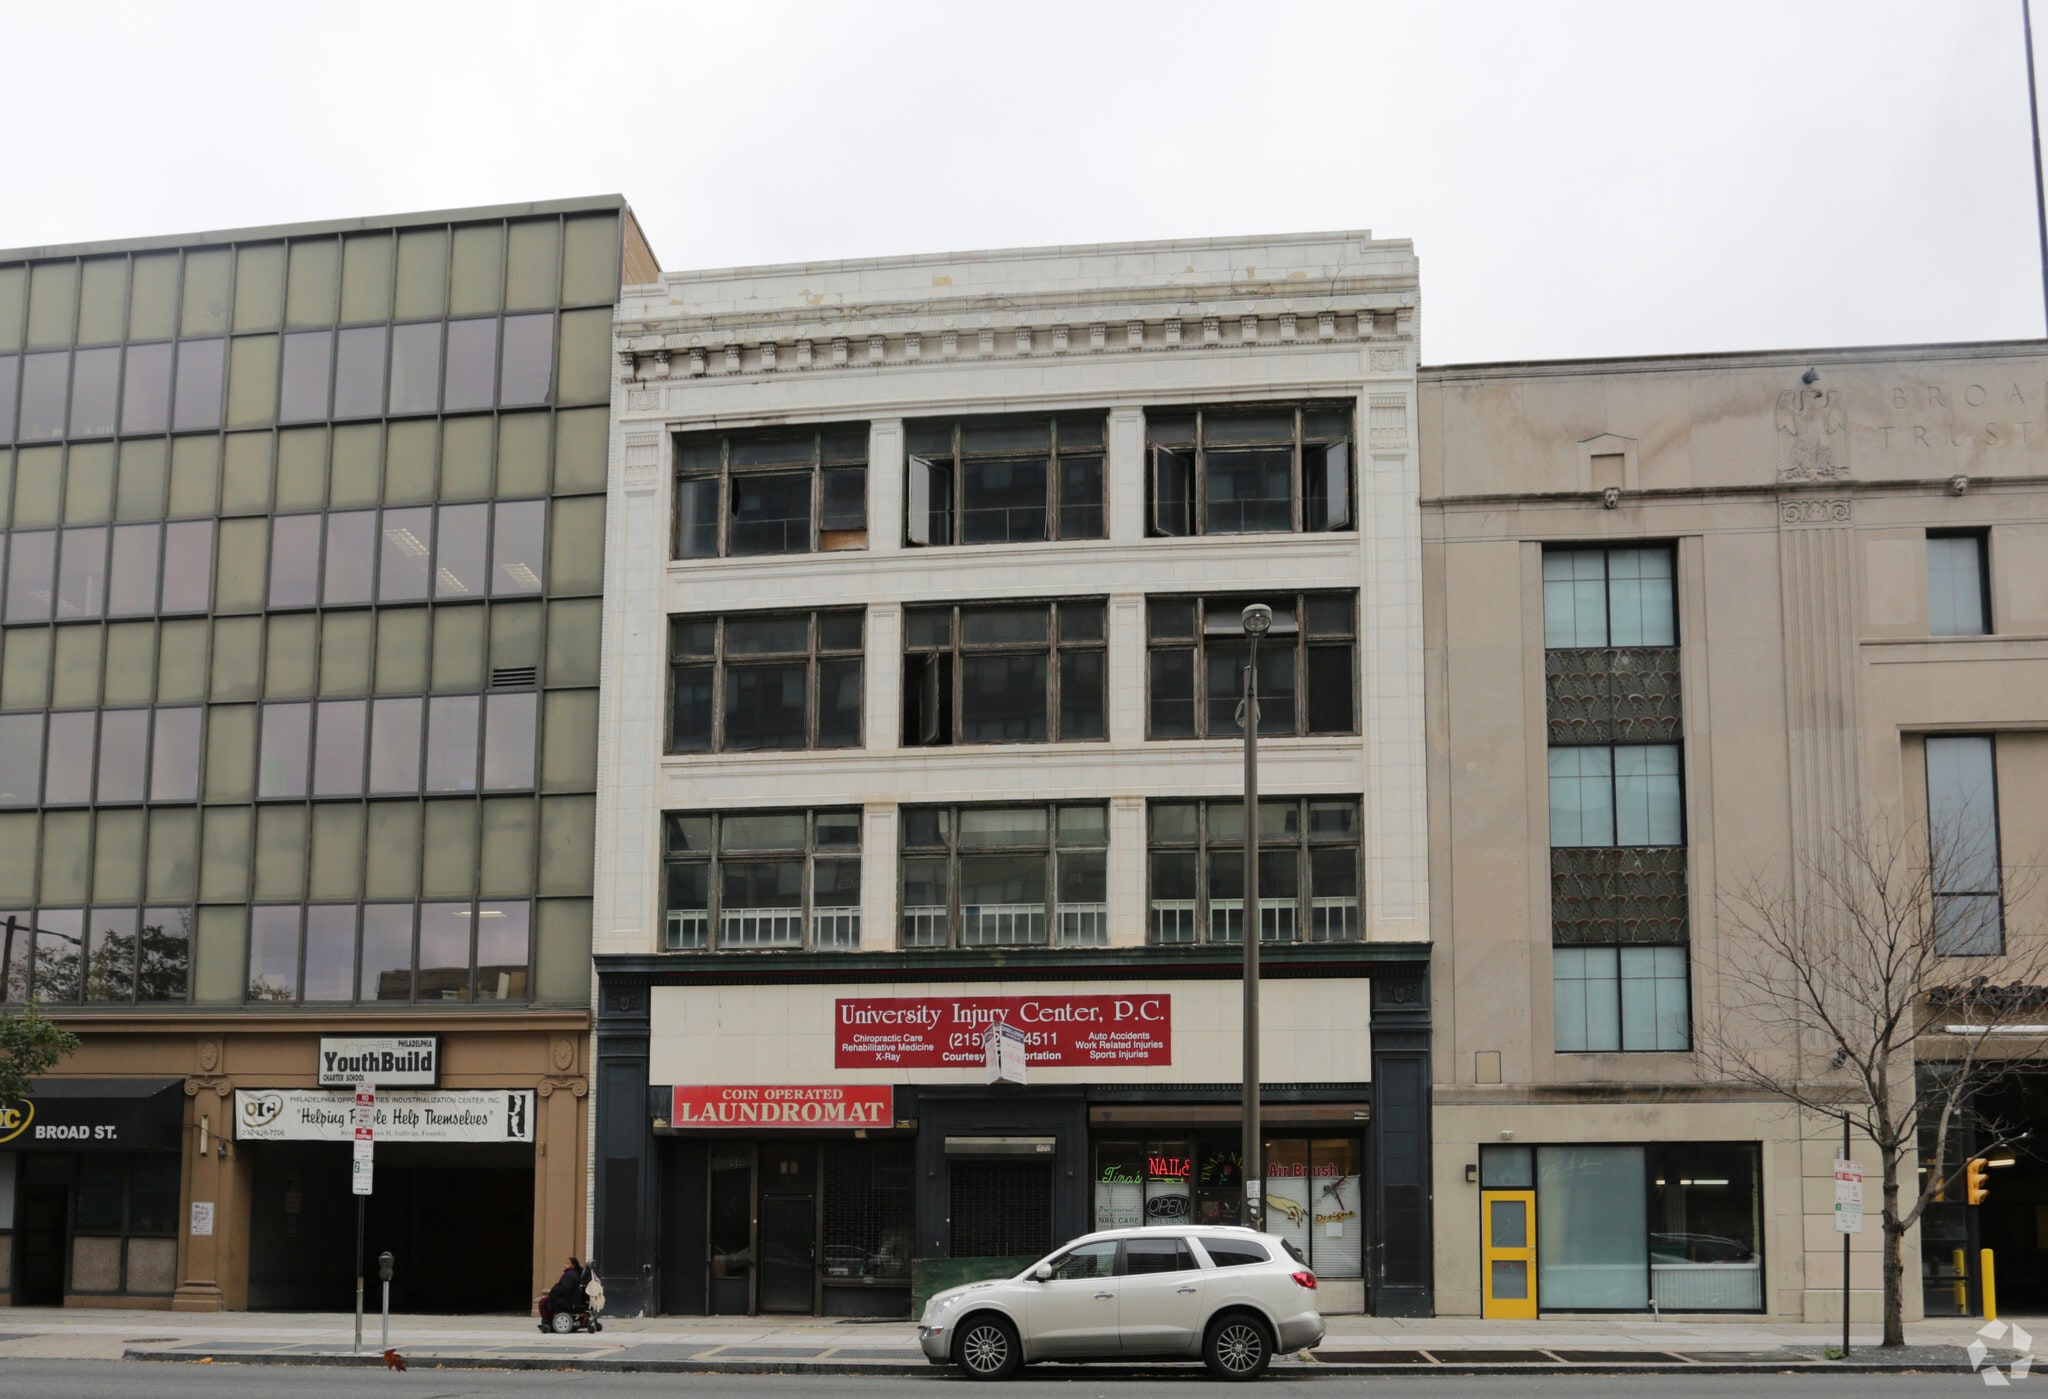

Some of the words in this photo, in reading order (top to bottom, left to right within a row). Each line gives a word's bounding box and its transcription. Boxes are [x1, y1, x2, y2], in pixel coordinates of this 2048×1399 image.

[1892, 383, 2048, 409] BROA
[1877, 421, 2032, 449] TRUST
[841, 1004, 942, 1031] University
[952, 1003, 1010, 1030] Injury
[1020, 1002, 1104, 1023] Center,
[1113, 1000, 1165, 1021] P.C.
[853, 1034, 902, 1043] Chiropractic
[903, 1033, 923, 1042] Care
[949, 1033, 985, 1050] (215)
[1088, 1032, 1108, 1040] Auto
[1110, 1031, 1150, 1040] Accidents
[842, 1043, 896, 1052] Rehabilitative
[898, 1043, 934, 1051] Medicine
[1075, 1041, 1097, 1049] Work
[1099, 1040, 1131, 1049] Related
[1133, 1040, 1164, 1050] Injuries
[324, 1051, 433, 1072] YouthBuild
[875, 1052, 901, 1062] X-Ray
[942, 1052, 986, 1062] Courtesy
[1089, 1050, 1117, 1060] Sports
[1118, 1050, 1149, 1060] Injuries
[722, 1090, 758, 1099] COIN
[764, 1089, 843, 1100] OPERATED
[393, 1108, 419, 1128] Help
[681, 1102, 884, 1122] LAUNDROMAT
[35, 1125, 90, 1139] BROAD
[94, 1125, 117, 1139] ST.
[1102, 1164, 1142, 1184] Tina's
[1268, 1163, 1288, 1177] Air
[1292, 1162, 1339, 1177] Brush
[1149, 1198, 1188, 1215] OPEN
